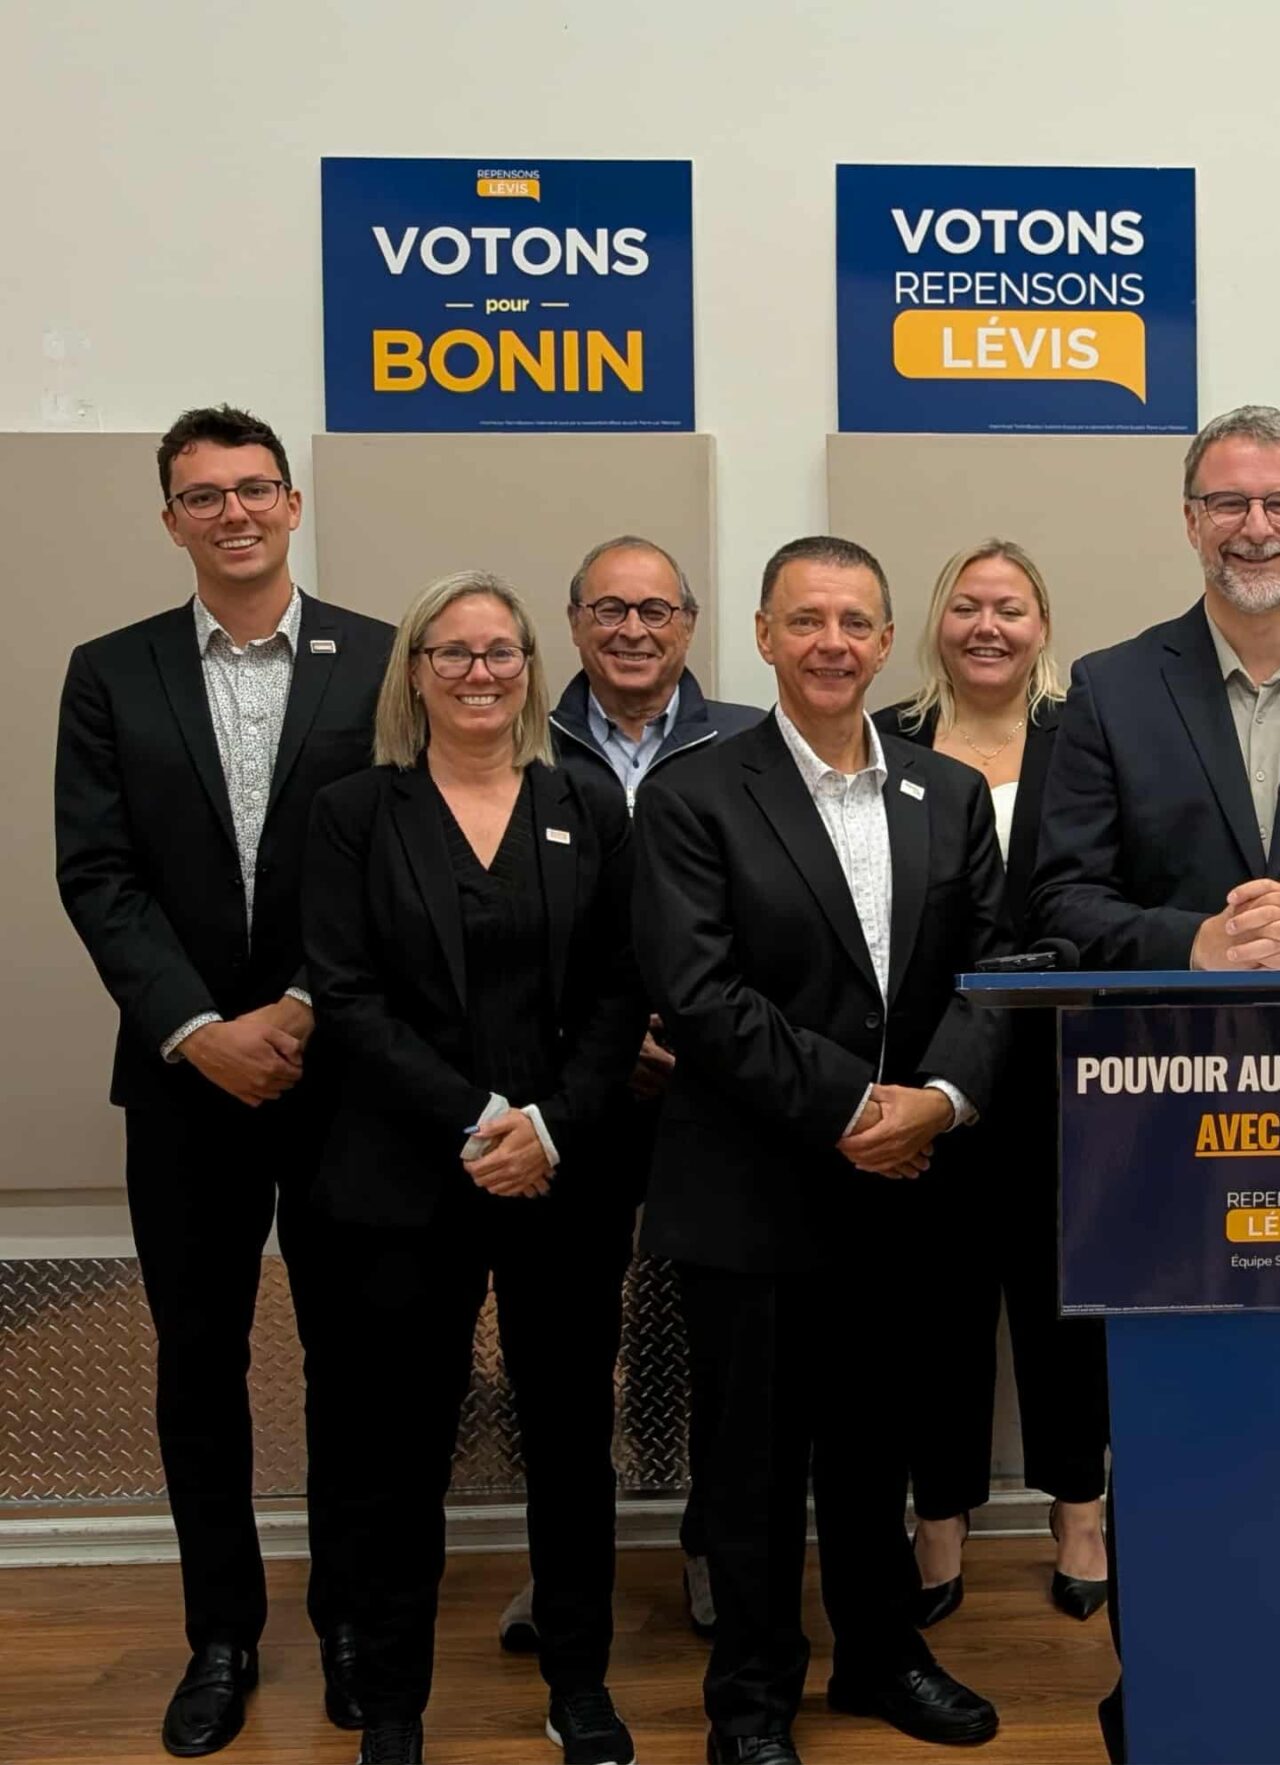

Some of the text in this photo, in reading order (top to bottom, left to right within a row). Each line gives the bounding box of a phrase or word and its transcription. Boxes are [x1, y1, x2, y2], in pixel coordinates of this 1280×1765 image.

[477, 169, 540, 179] REPENSONS
[489, 181, 528, 194] LÉVIS
[372, 226, 650, 276] VOTONS
[891, 209, 1145, 256] VOTONS
[485, 297, 530, 315] pour
[895, 271, 1145, 306] REPENSONS
[373, 329, 644, 392] BONIN
[942, 316, 1100, 370] LÉVIS
[1076, 1055, 1228, 1095] POUVOIR
[1196, 1112, 1280, 1151] AVEC
[1231, 1253, 1272, 1269] Équipe
